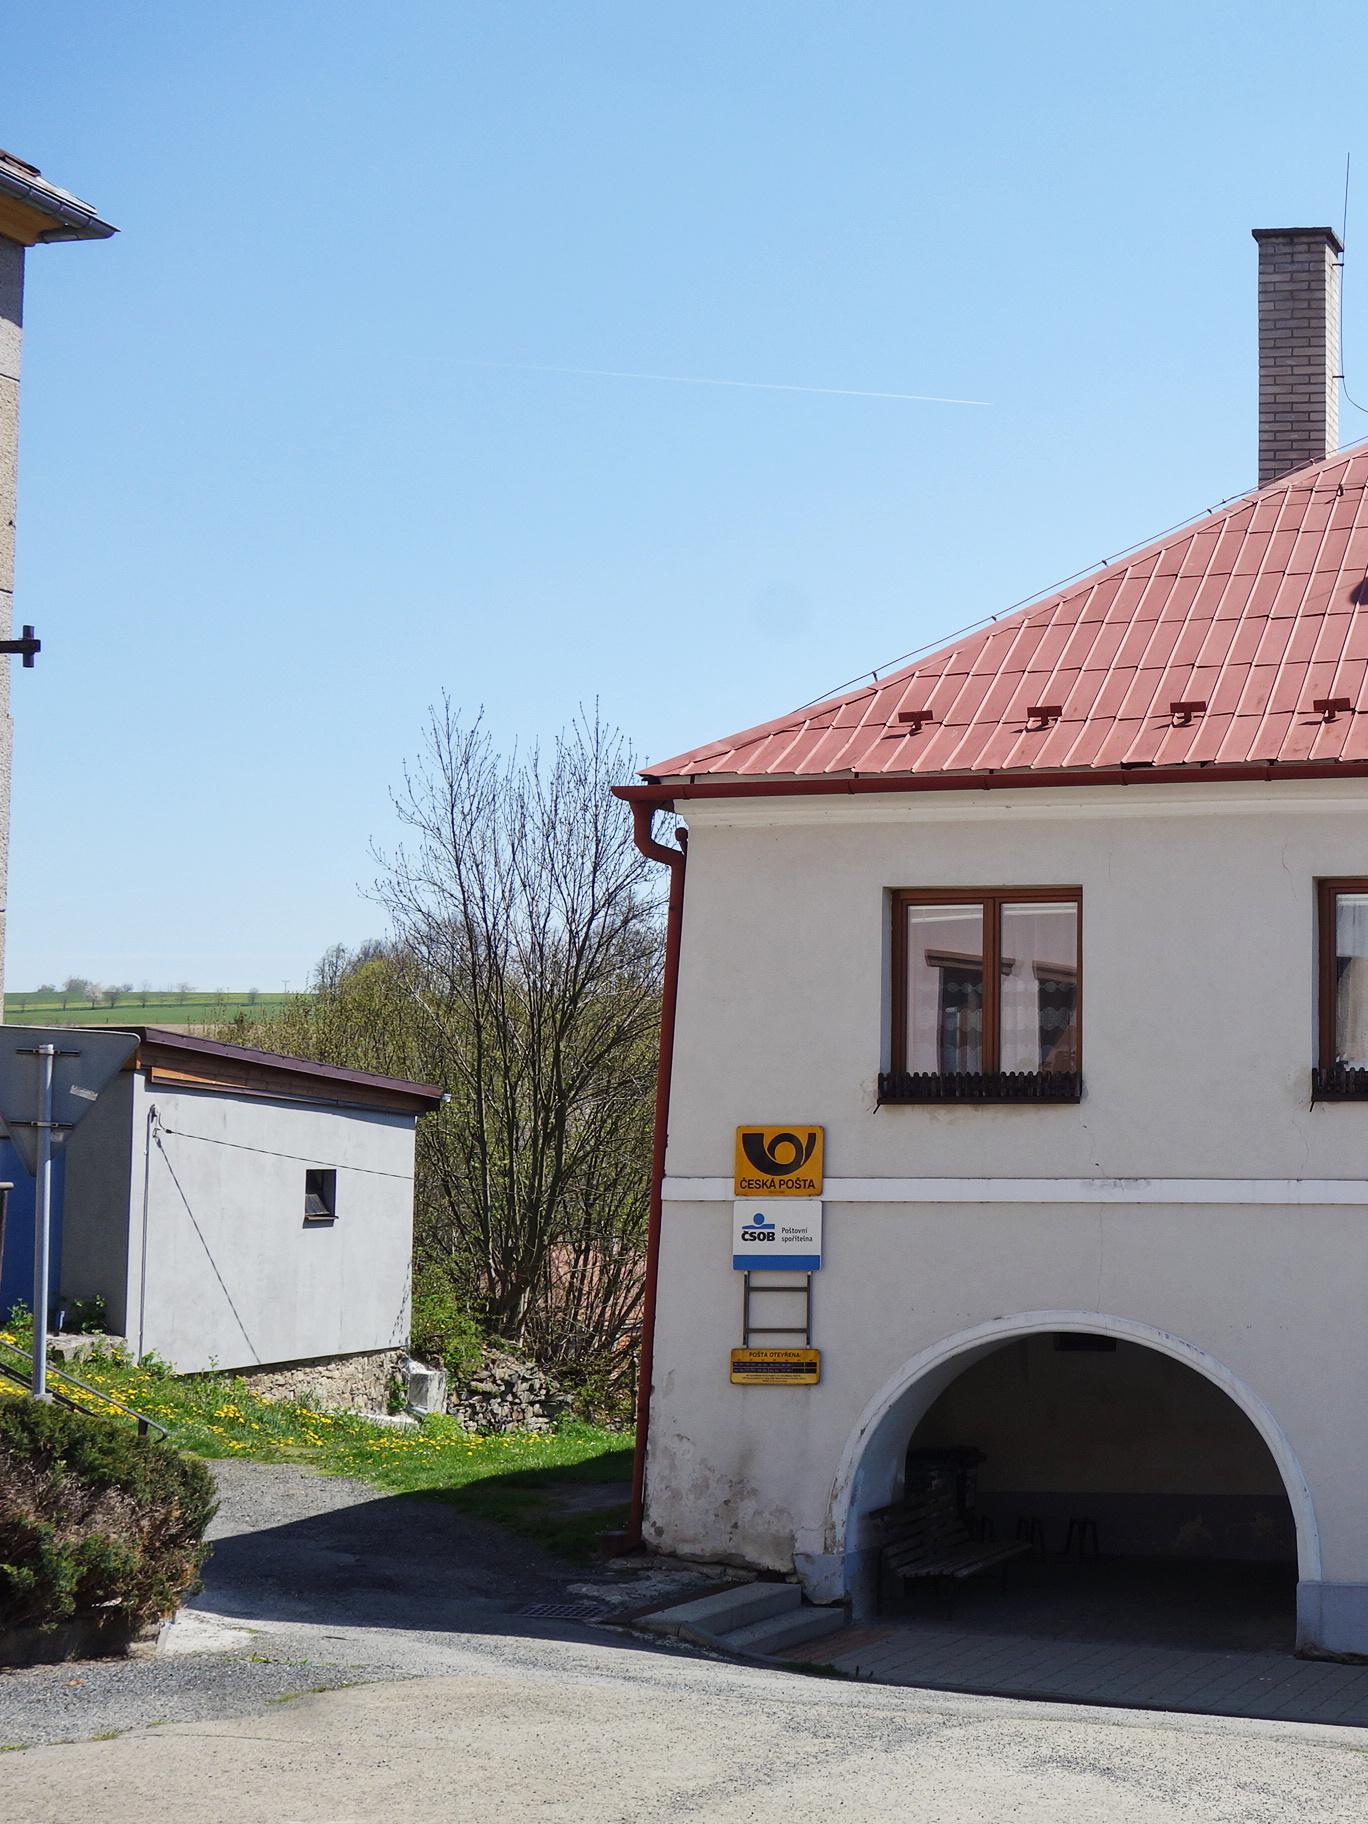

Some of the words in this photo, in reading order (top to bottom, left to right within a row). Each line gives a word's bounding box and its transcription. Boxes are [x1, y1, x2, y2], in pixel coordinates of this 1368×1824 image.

[740, 1177, 776, 1190] ČESKÁ
[779, 1177, 816, 1190] POŠTA
[741, 1231, 776, 1242] ČSOB
